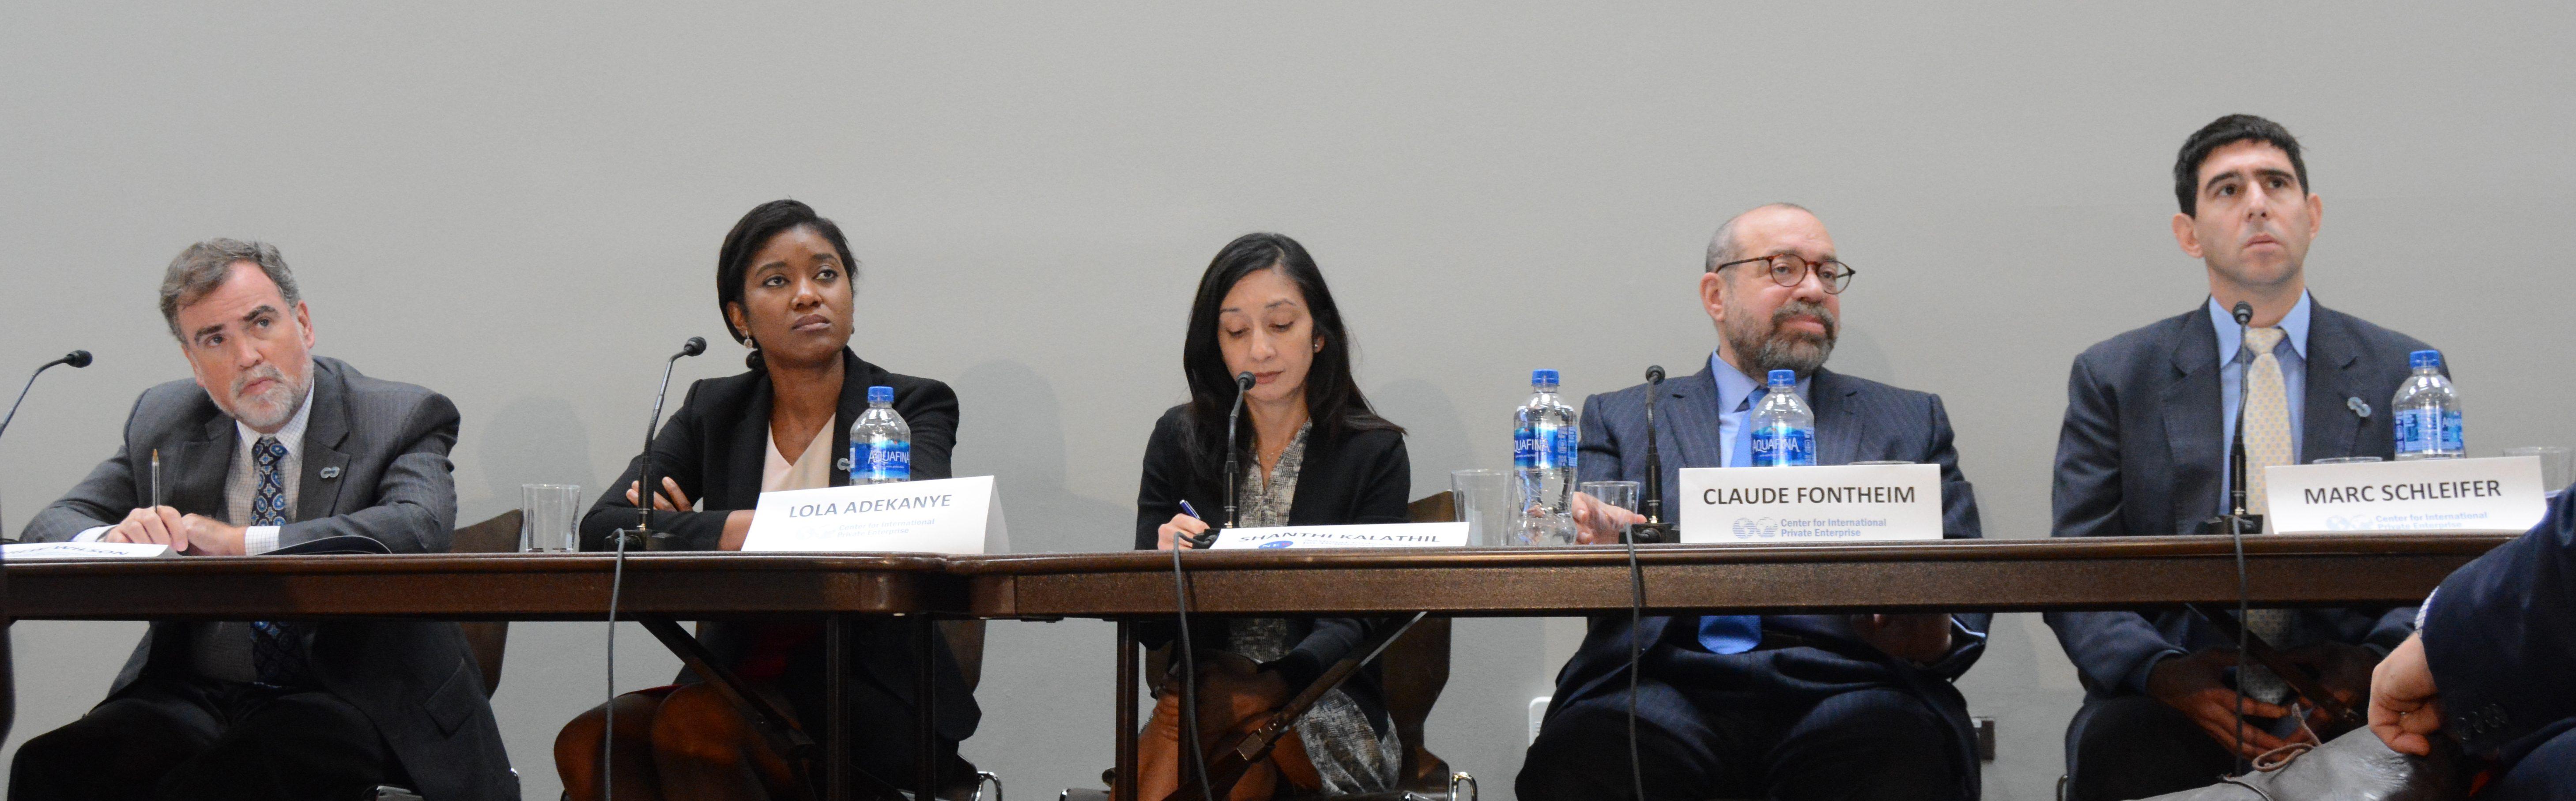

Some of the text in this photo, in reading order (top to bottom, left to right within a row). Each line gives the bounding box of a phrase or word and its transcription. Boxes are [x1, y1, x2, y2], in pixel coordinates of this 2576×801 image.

[1515, 439, 1552, 453] QUAFINA
[1703, 486, 1915, 505] CLAUDE FONTHEIM
[2304, 480, 2501, 504] MARC SCHLEIFER
[789, 494, 952, 518] LOLA ADEKANYE
[2425, 511, 2488, 521] International
[882, 519, 935, 528] International
[1780, 518, 1886, 527] Center for International
[1239, 532, 1333, 542] SHANTHI
[1815, 529, 1861, 538] Enterprise
[54, 545, 129, 555] WILSON
